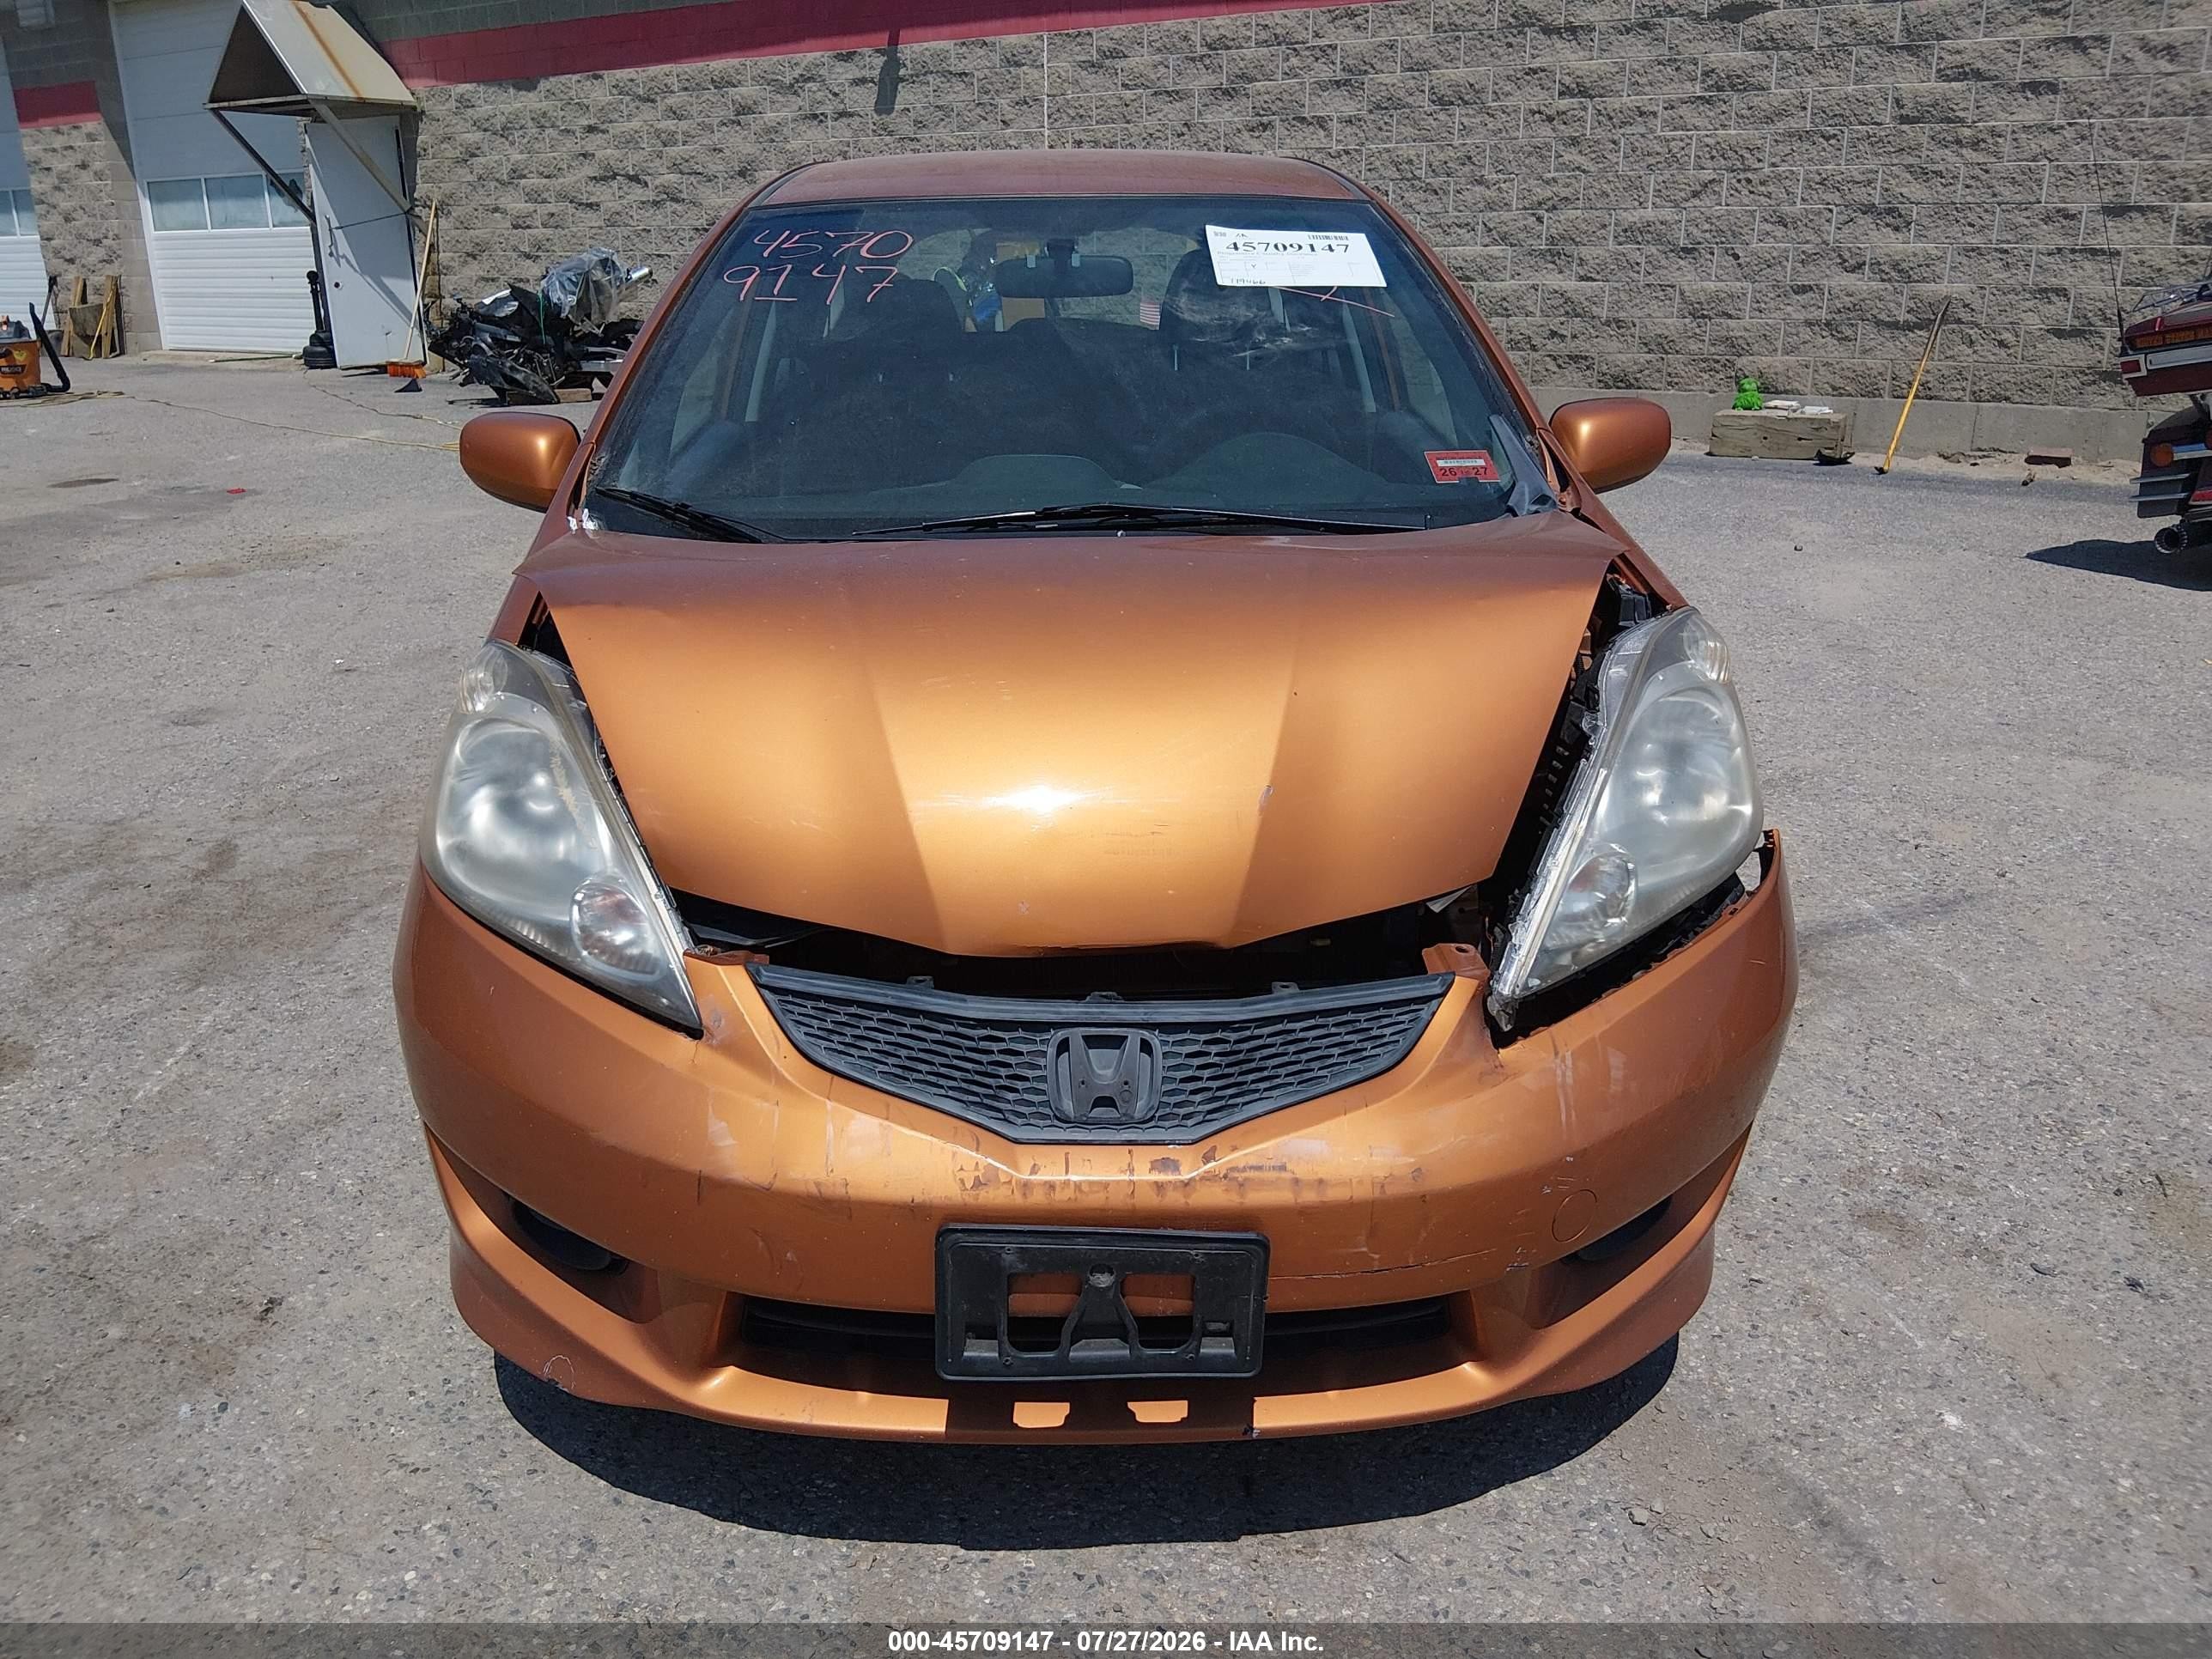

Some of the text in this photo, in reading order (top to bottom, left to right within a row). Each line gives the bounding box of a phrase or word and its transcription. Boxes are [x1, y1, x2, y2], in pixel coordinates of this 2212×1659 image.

[753, 229, 915, 258] 4570
[1225, 241, 1351, 253] 45709147
[1439, 467, 1457, 477] 26
[1472, 466, 1488, 476] 27
